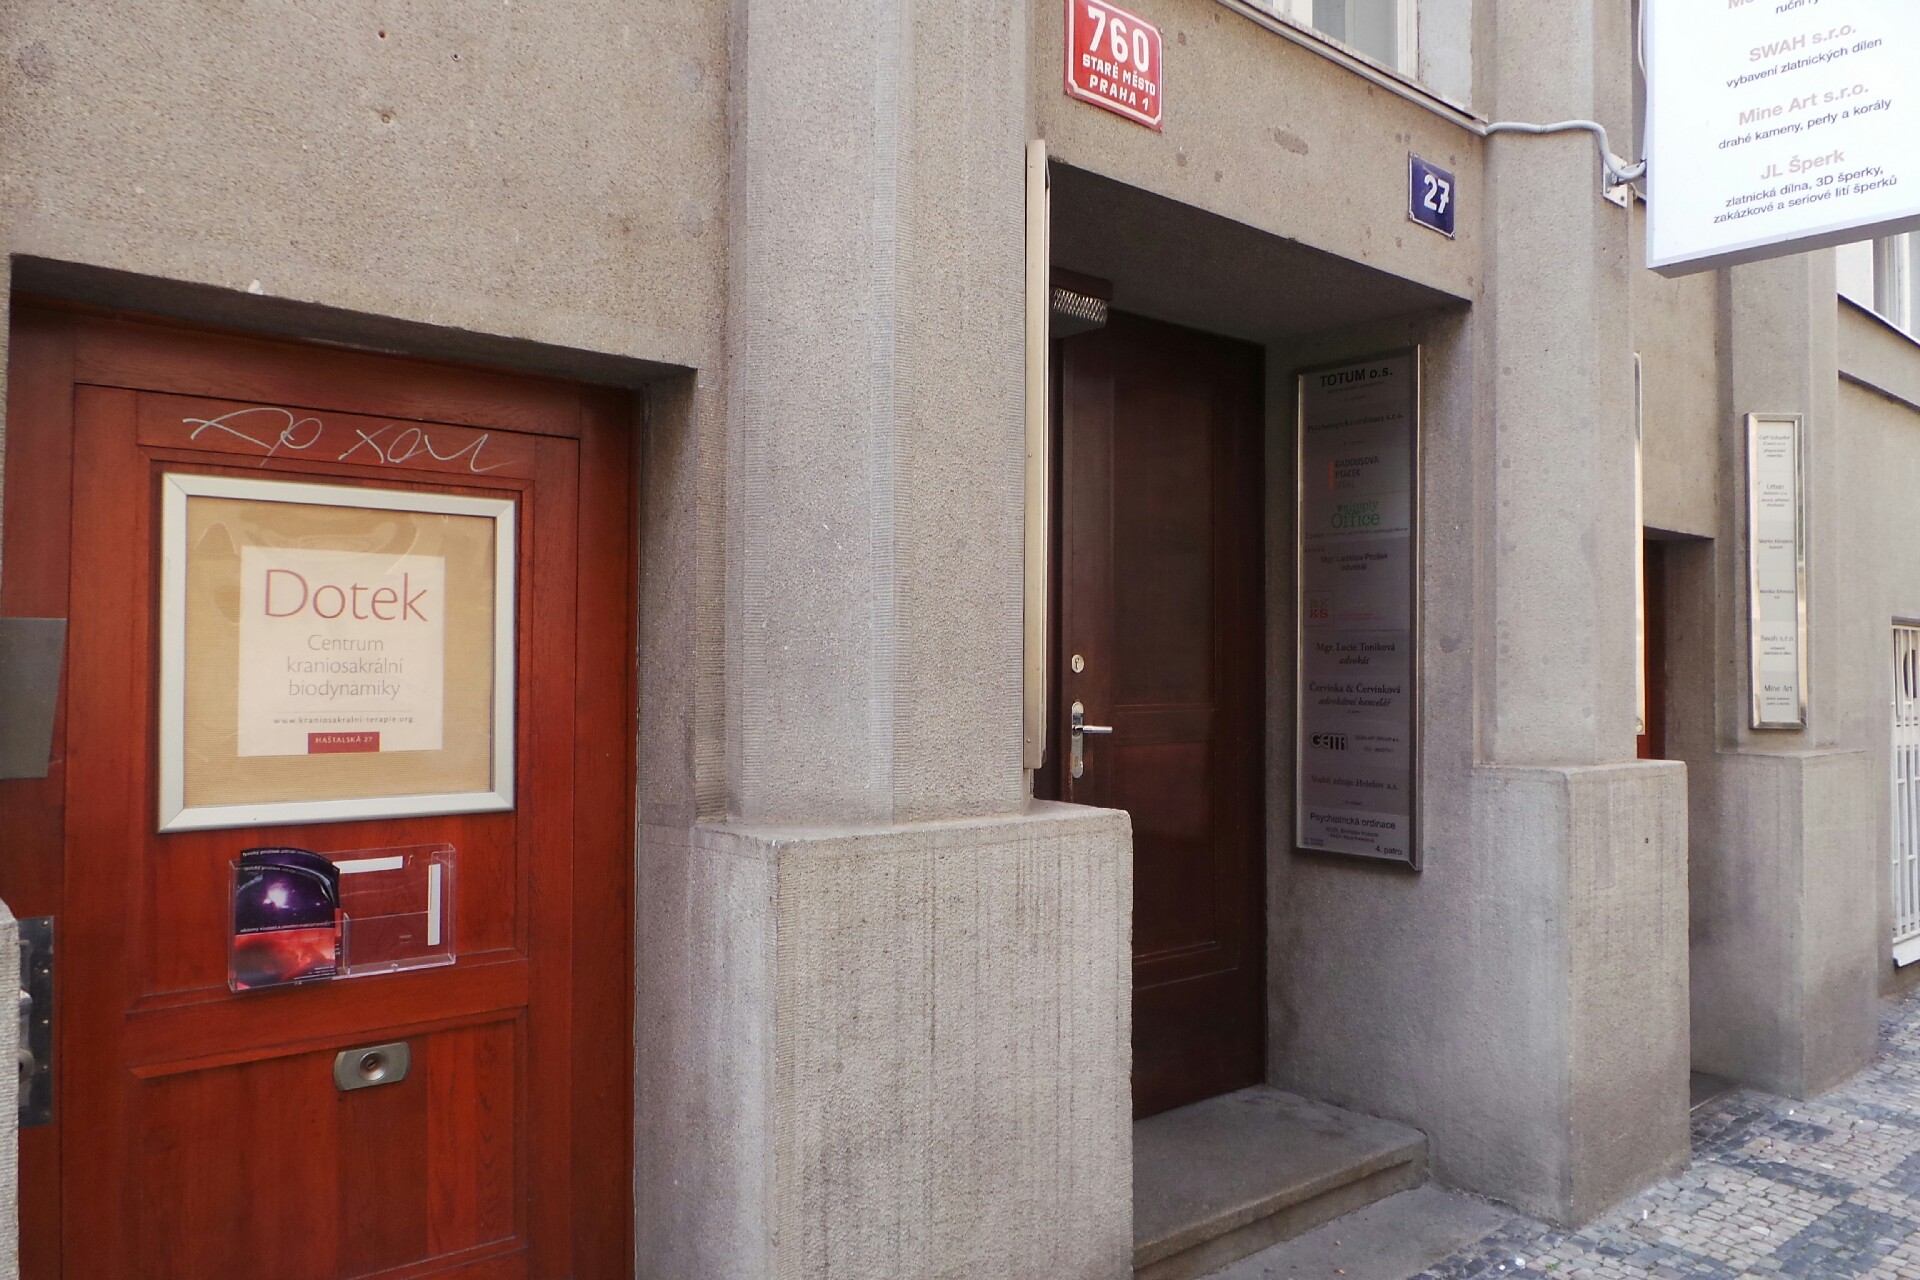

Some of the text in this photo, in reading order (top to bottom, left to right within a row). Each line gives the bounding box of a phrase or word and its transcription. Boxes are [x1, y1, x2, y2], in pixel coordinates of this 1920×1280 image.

[1088, 5, 1150, 73] 760
[1749, 24, 1857, 62] SWAH s.r.o.
[1082, 53, 1156, 96] STARÉ MĚSTO
[1726, 38, 1883, 88] vybavení zlatnických dílen
[1089, 74, 1149, 111] PRAHA 1
[1738, 83, 1869, 126] Mine Art s.r.o.
[1718, 98, 1892, 150] drahé kameny, perly a korály
[1760, 149, 1845, 180] JL Šperk
[1424, 174, 1450, 214] 27
[1713, 201, 1774, 224] zakázkové
[1777, 202, 1785, 210] a
[1853, 174, 1898, 195] šperků
[1725, 166, 1884, 208] zlatnická dílna, 3D šperky,
[1320, 368, 1366, 388] TOTUM
[1370, 367, 1393, 379] o.s.
[1331, 512, 1380, 529] Office
[265, 568, 429, 622] Dotek
[308, 634, 384, 651] Centrum
[287, 656, 404, 674] kraniosakrální
[288, 679, 401, 701] biodynamiky
[1345, 684, 1354, 693] &
[315, 735, 361, 744] HAŠTALSKÁ
[1362, 819, 1396, 830] ordinace
[1383, 846, 1402, 856] patro
